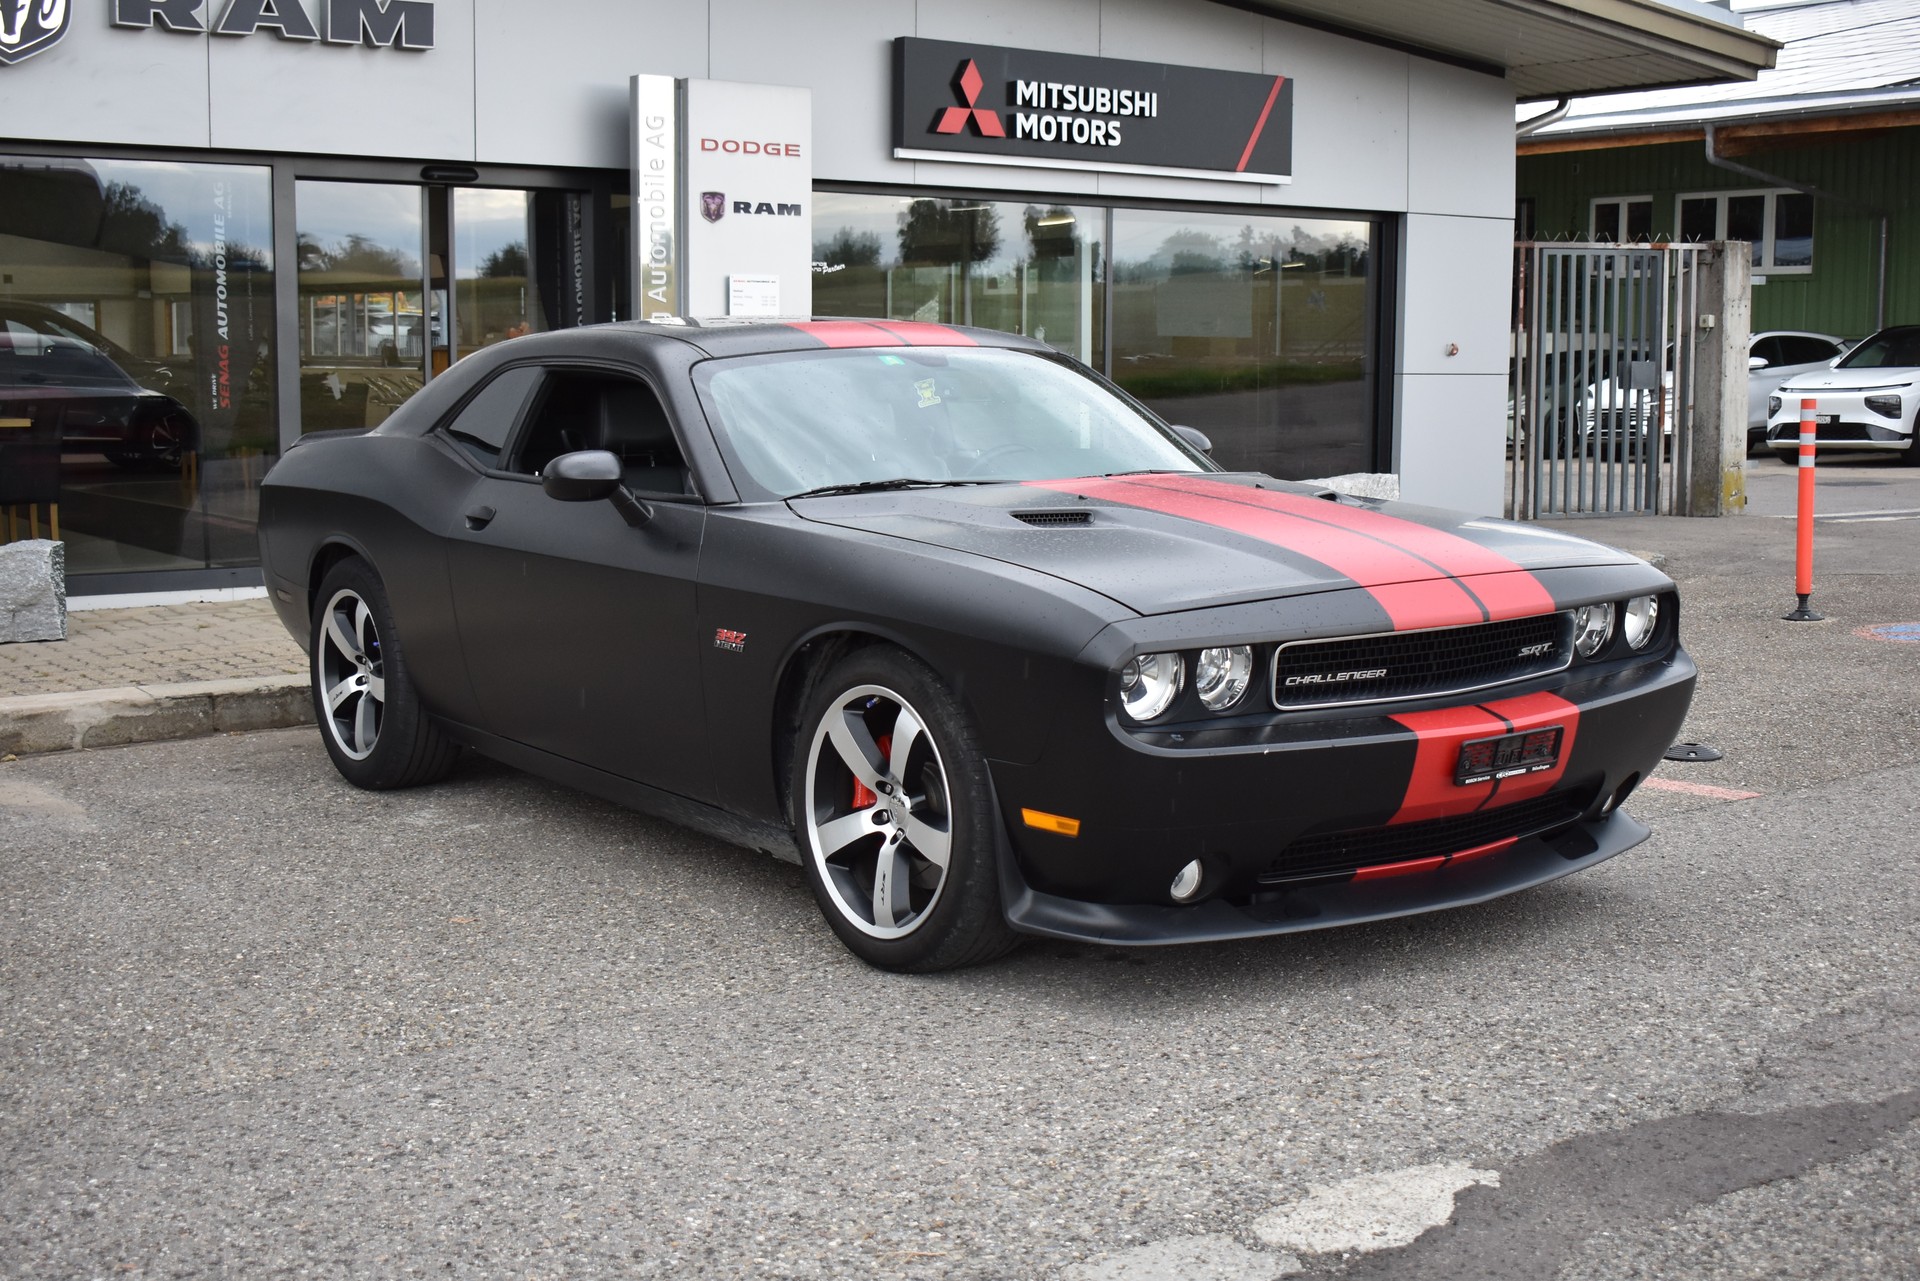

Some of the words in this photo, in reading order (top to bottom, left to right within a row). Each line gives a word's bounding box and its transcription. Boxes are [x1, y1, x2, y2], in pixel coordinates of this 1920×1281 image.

[113, 0, 435, 50] RAM
[1016, 79, 1158, 118] MITSUBISHI
[645, 115, 665, 149] AG
[1015, 112, 1122, 147] MOTORS
[700, 138, 801, 158] DODGE
[213, 181, 225, 210] AG
[733, 201, 802, 217] RAM
[644, 158, 667, 303] Automobile
[214, 213, 229, 340] AUTOMOBILE
[218, 344, 231, 409] SENAG
[715, 628, 747, 645] 392
[1518, 642, 1553, 657] SRT
[1285, 668, 1388, 686] CHALLENGER
